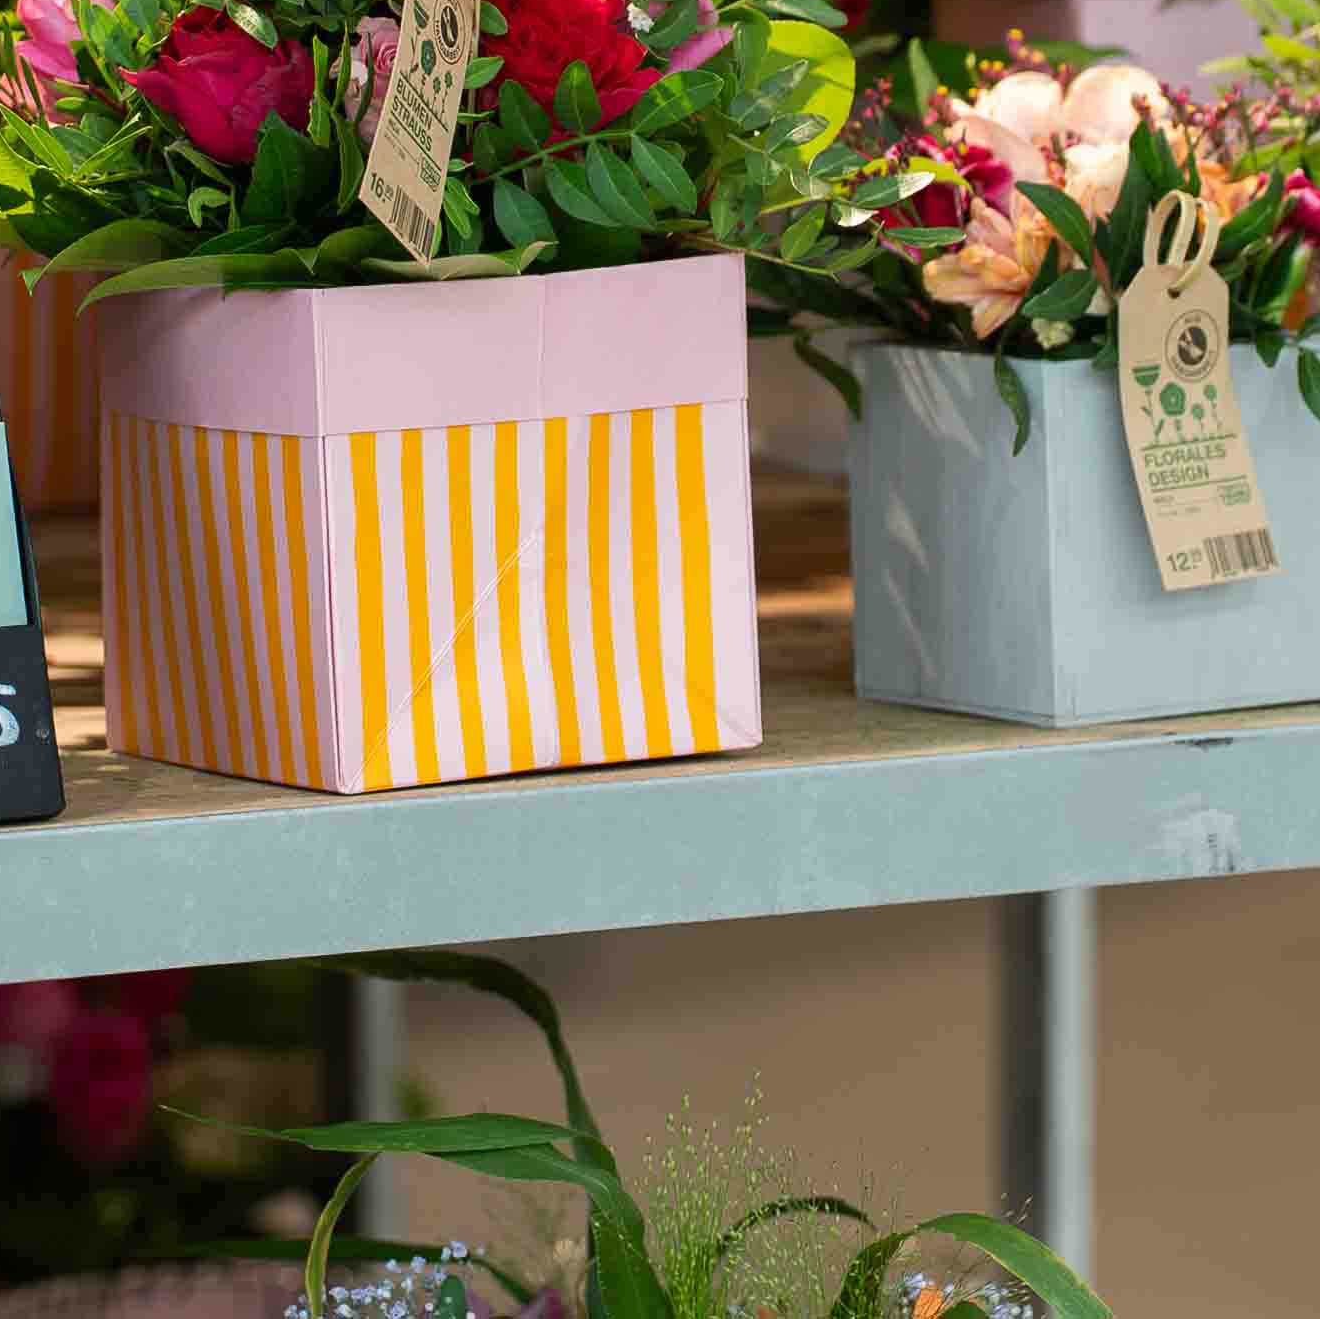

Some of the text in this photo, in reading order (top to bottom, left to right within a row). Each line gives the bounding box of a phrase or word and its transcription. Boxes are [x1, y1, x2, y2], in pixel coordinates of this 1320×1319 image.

[396, 78, 433, 131] BLUMEN
[392, 96, 433, 152] STRAUSS
[1144, 443, 1226, 467] FLORALES
[1148, 464, 1210, 488] DESIGN
